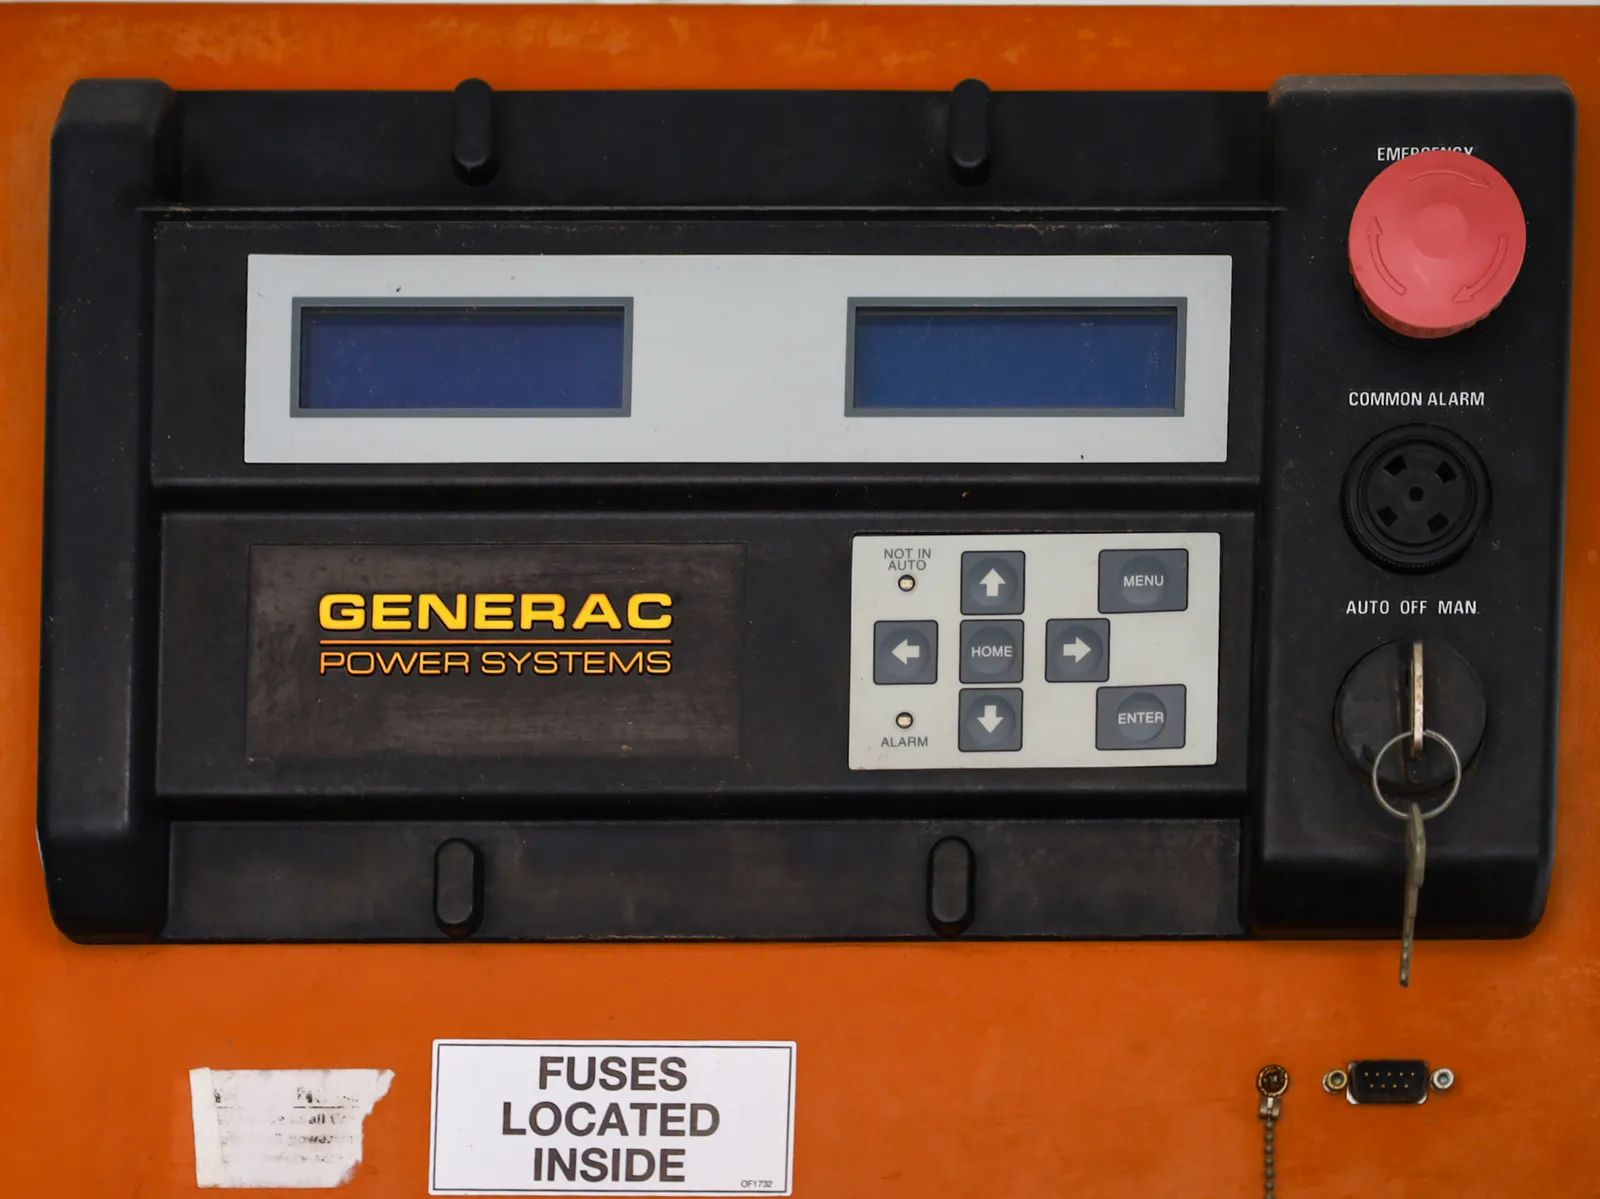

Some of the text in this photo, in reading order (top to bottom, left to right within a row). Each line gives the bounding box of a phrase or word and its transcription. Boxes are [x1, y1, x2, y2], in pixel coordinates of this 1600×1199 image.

[1349, 391, 1485, 406] COMMON ALARM
[883, 548, 932, 560] NOT IN
[887, 560, 927, 571] AUTO
[1123, 574, 1164, 588] MENU
[318, 593, 673, 631] GENERAC
[1346, 600, 1390, 614] AUTO
[1400, 600, 1428, 614] OFF
[971, 645, 1013, 658] HOME
[319, 651, 672, 675] POWER SYSTEMS
[1117, 711, 1164, 725] ENTER
[880, 736, 929, 748] ALARM
[538, 1056, 688, 1092] FUSES
[501, 1101, 721, 1138] LOCATED
[533, 1147, 686, 1183] INSIDE
